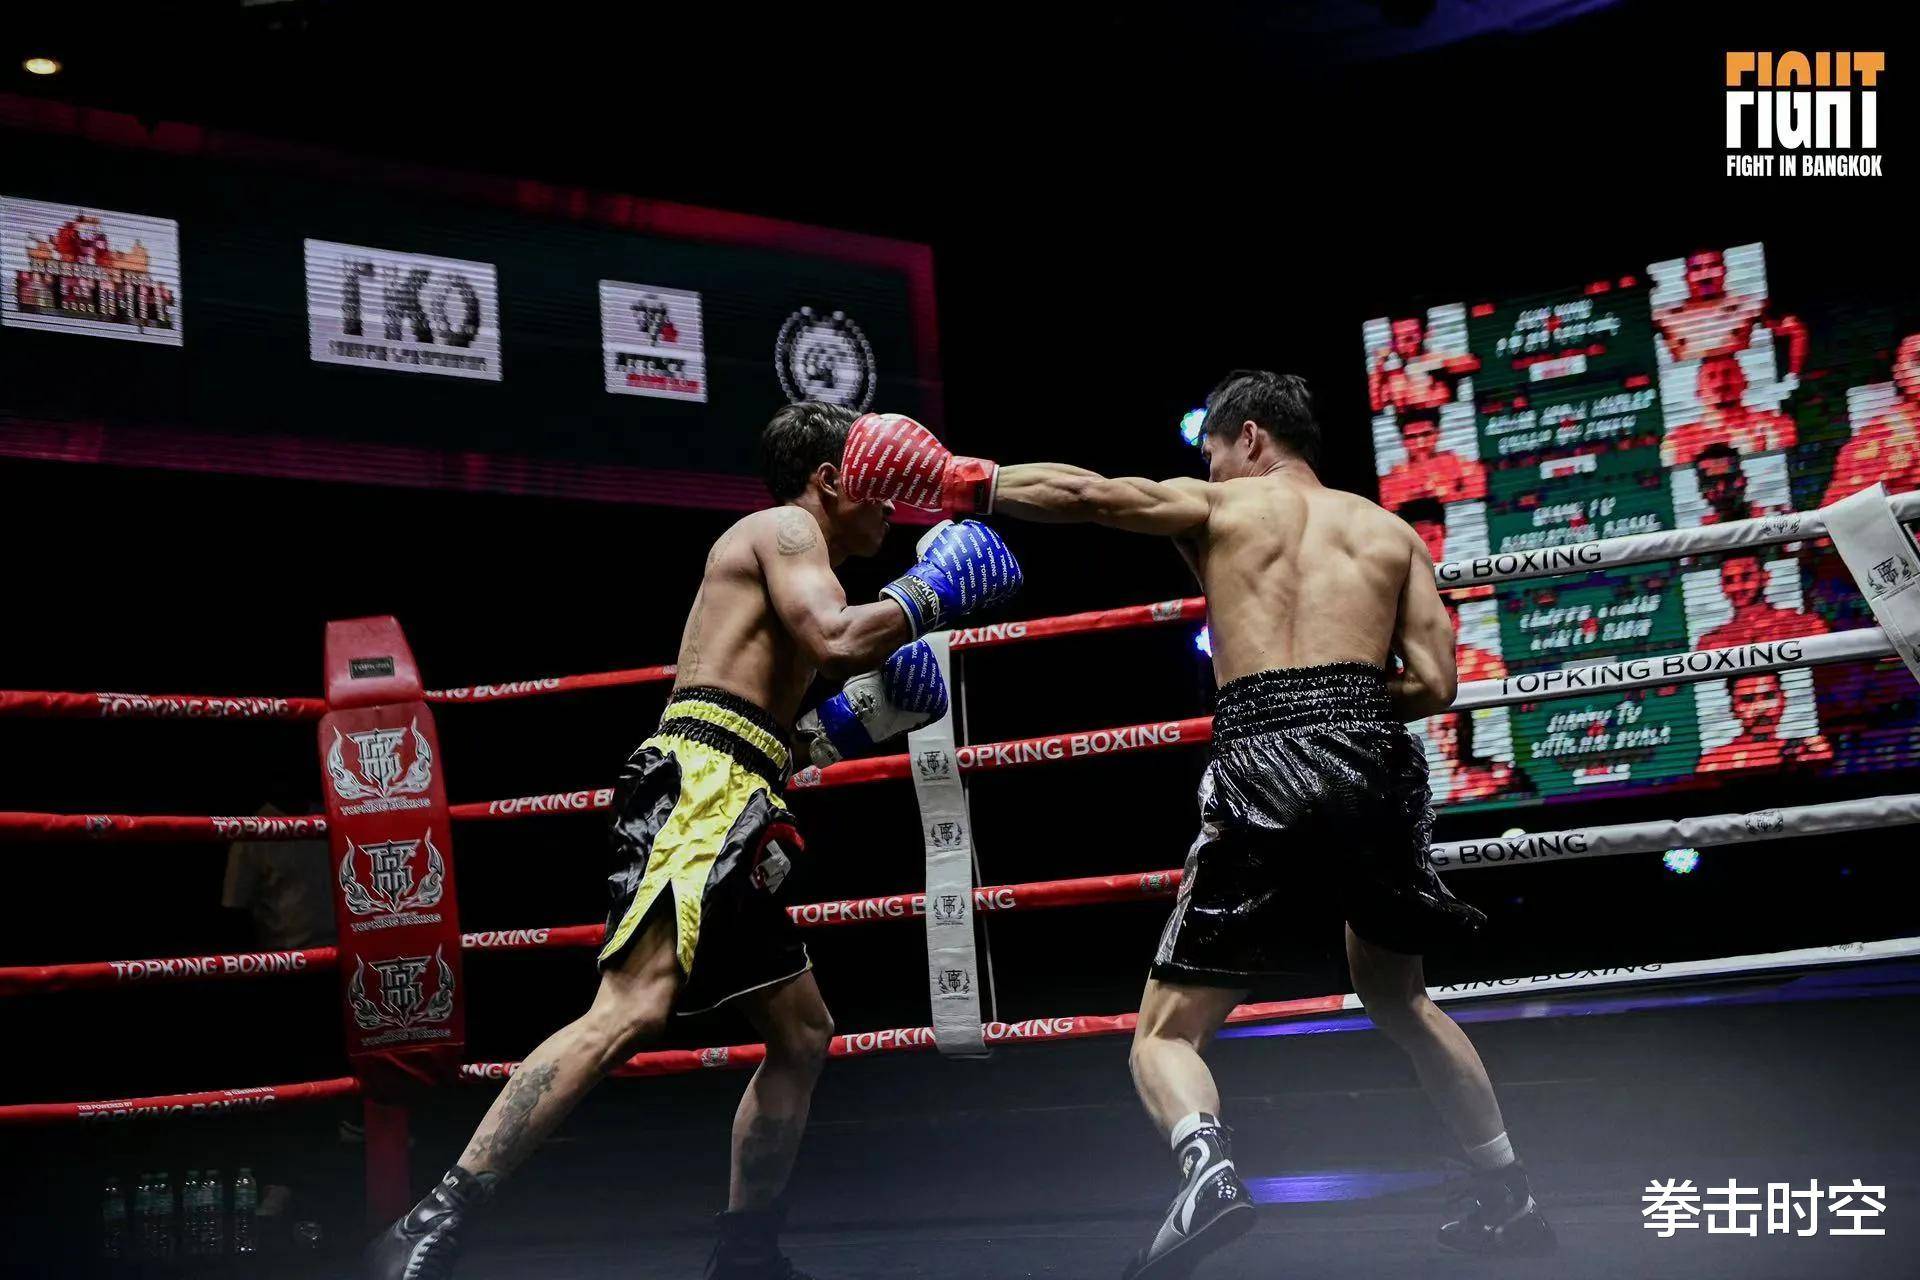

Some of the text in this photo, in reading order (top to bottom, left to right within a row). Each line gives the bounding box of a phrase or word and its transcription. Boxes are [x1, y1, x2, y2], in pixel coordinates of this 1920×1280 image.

[1472, 544, 1602, 578] BOXING
[949, 622, 1027, 647] XING
[1501, 641, 1803, 696] TOPKING BOXING
[956, 721, 1181, 769] OPKING BOXING
[489, 790, 589, 815] TOPKING
[1460, 833, 1588, 866] BOXING
[789, 888, 1017, 925] TOPKING BNG
[461, 928, 550, 948] BOXING
[109, 951, 306, 982] TOPKING BOXING
[842, 1027, 937, 1054] TOPKIN
